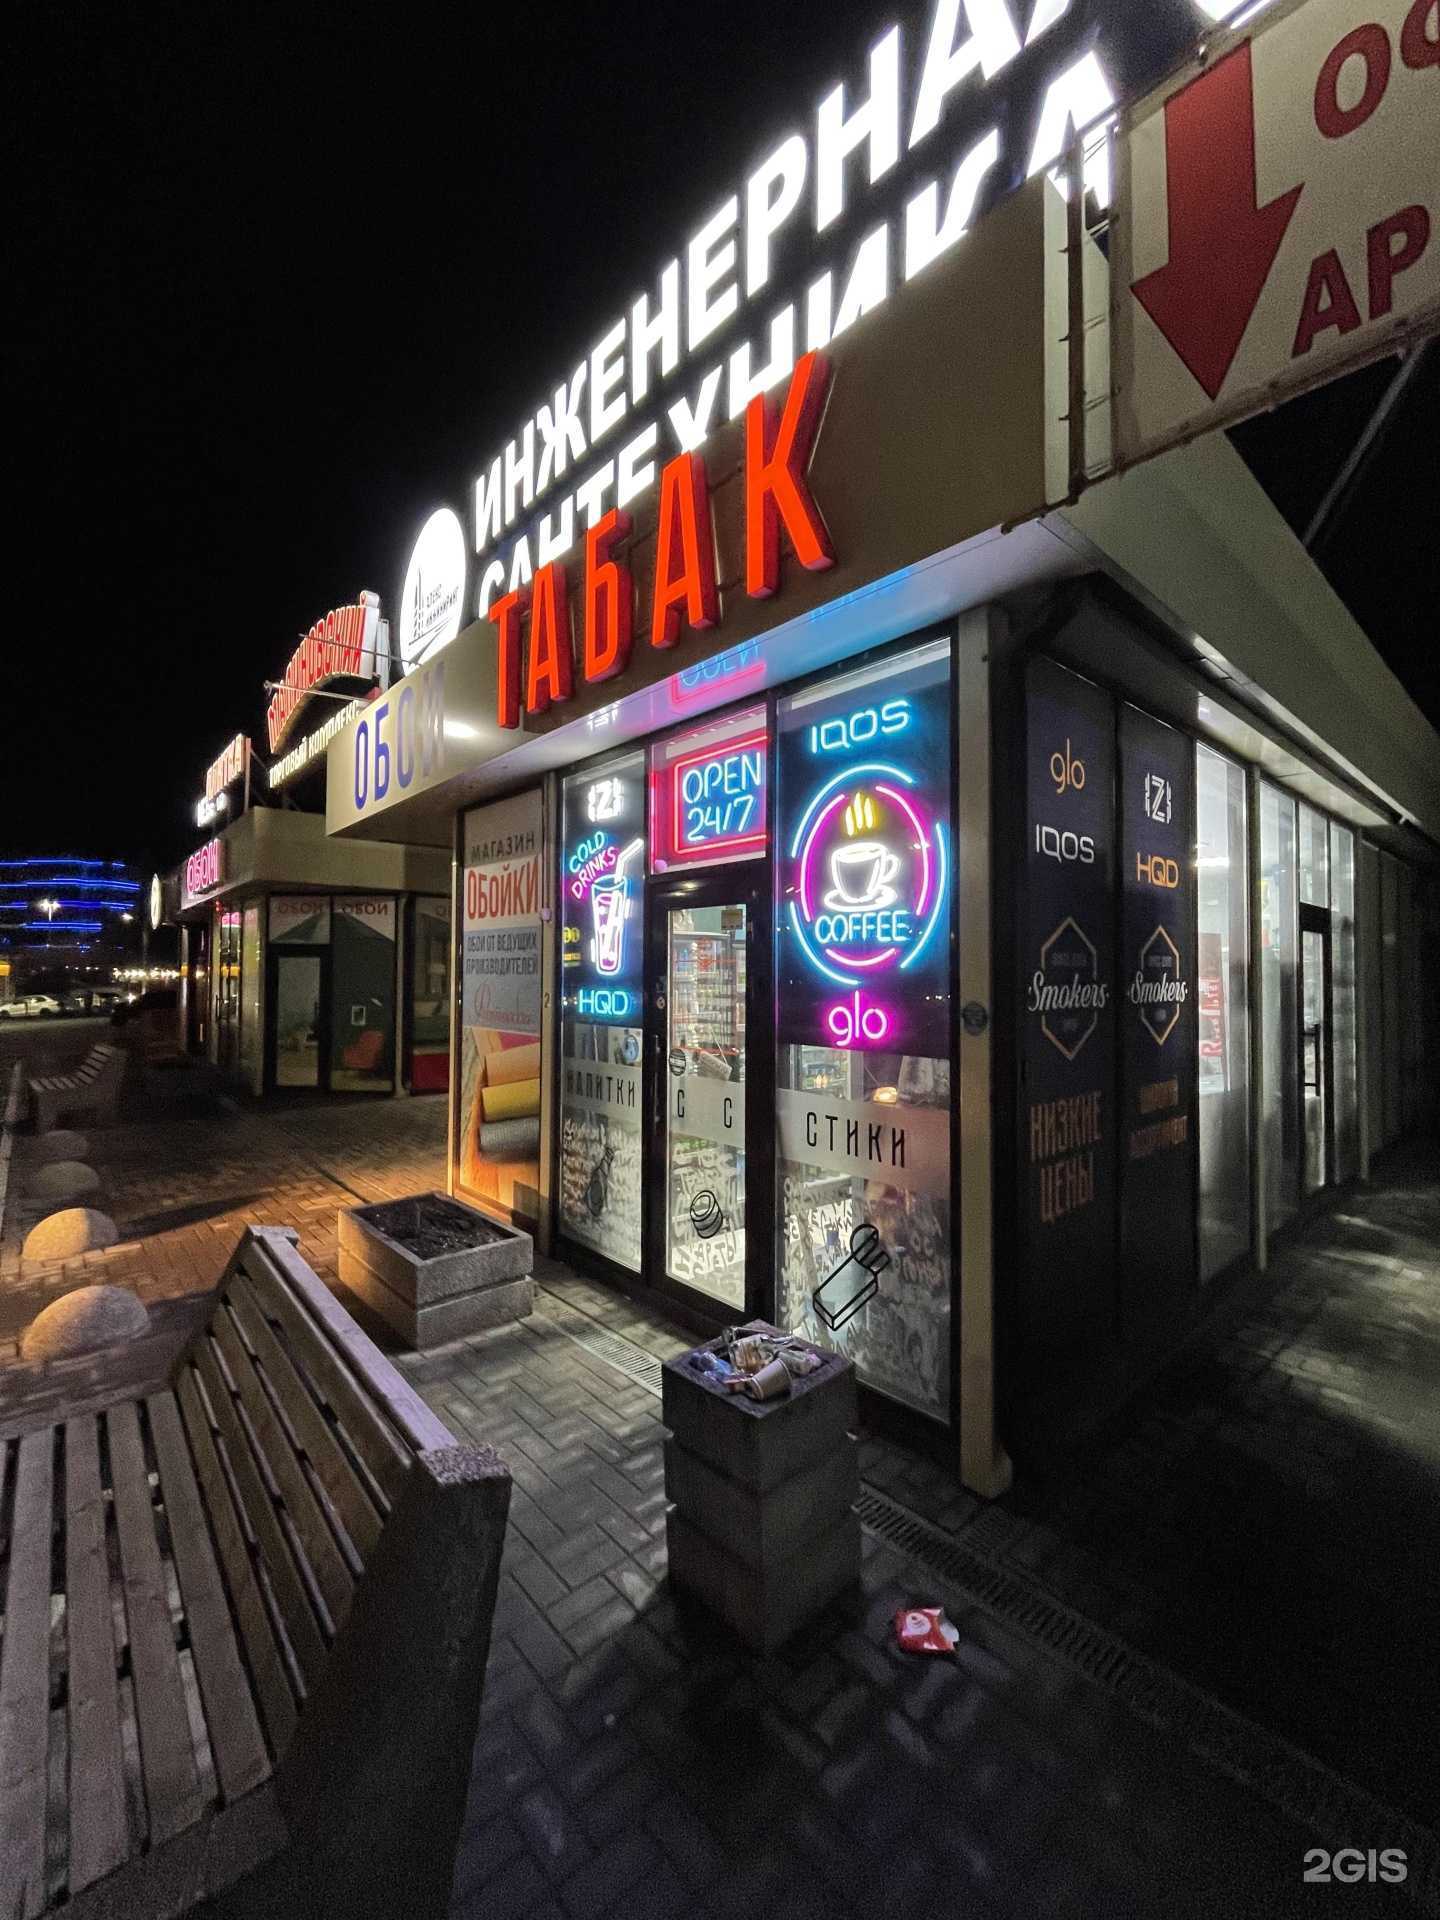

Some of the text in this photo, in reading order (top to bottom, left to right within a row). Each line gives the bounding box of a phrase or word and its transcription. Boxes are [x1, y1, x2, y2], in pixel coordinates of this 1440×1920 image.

[475, 0, 1072, 553] ИНЖЕНЕРНА
[489, 350, 836, 729] ТАБАК
[269, 699, 360, 788] ТОРГОВЫЙ КОМПЛЕКС
[354, 661, 447, 810] ОБОИ
[811, 699, 912, 753] IQOS
[205, 734, 244, 802] ПЛИТКА
[681, 751, 762, 805] OPEN
[1050, 737, 1086, 794] glo
[686, 795, 756, 842] 24/7
[1035, 823, 1095, 864] IQOS
[186, 837, 220, 894] ОБОИ
[471, 832, 535, 864] МАГАЗИН
[568, 831, 606, 874] COLD
[570, 846, 619, 900] DRINKS
[1136, 852, 1180, 889] HQD
[466, 855, 540, 921] ОБОЙКИ
[467, 931, 537, 953] ОБОИ ОТ ВЕДУЩИХ
[814, 908, 914, 944] COFFEE
[466, 954, 538, 977] ПРОИЗВОДИТЕЛЕЙ
[1029, 970, 1106, 1012] Smokers
[1130, 970, 1186, 1004] Smokers
[577, 989, 630, 1016] HQD
[828, 989, 889, 1046] glo
[566, 1070, 636, 1108] НАПИТКИ
[806, 1111, 906, 1169] СТИКИ
[1029, 1090, 1101, 1163] НИЗКИЕ
[1040, 1152, 1094, 1225] ЦЕНЫ
